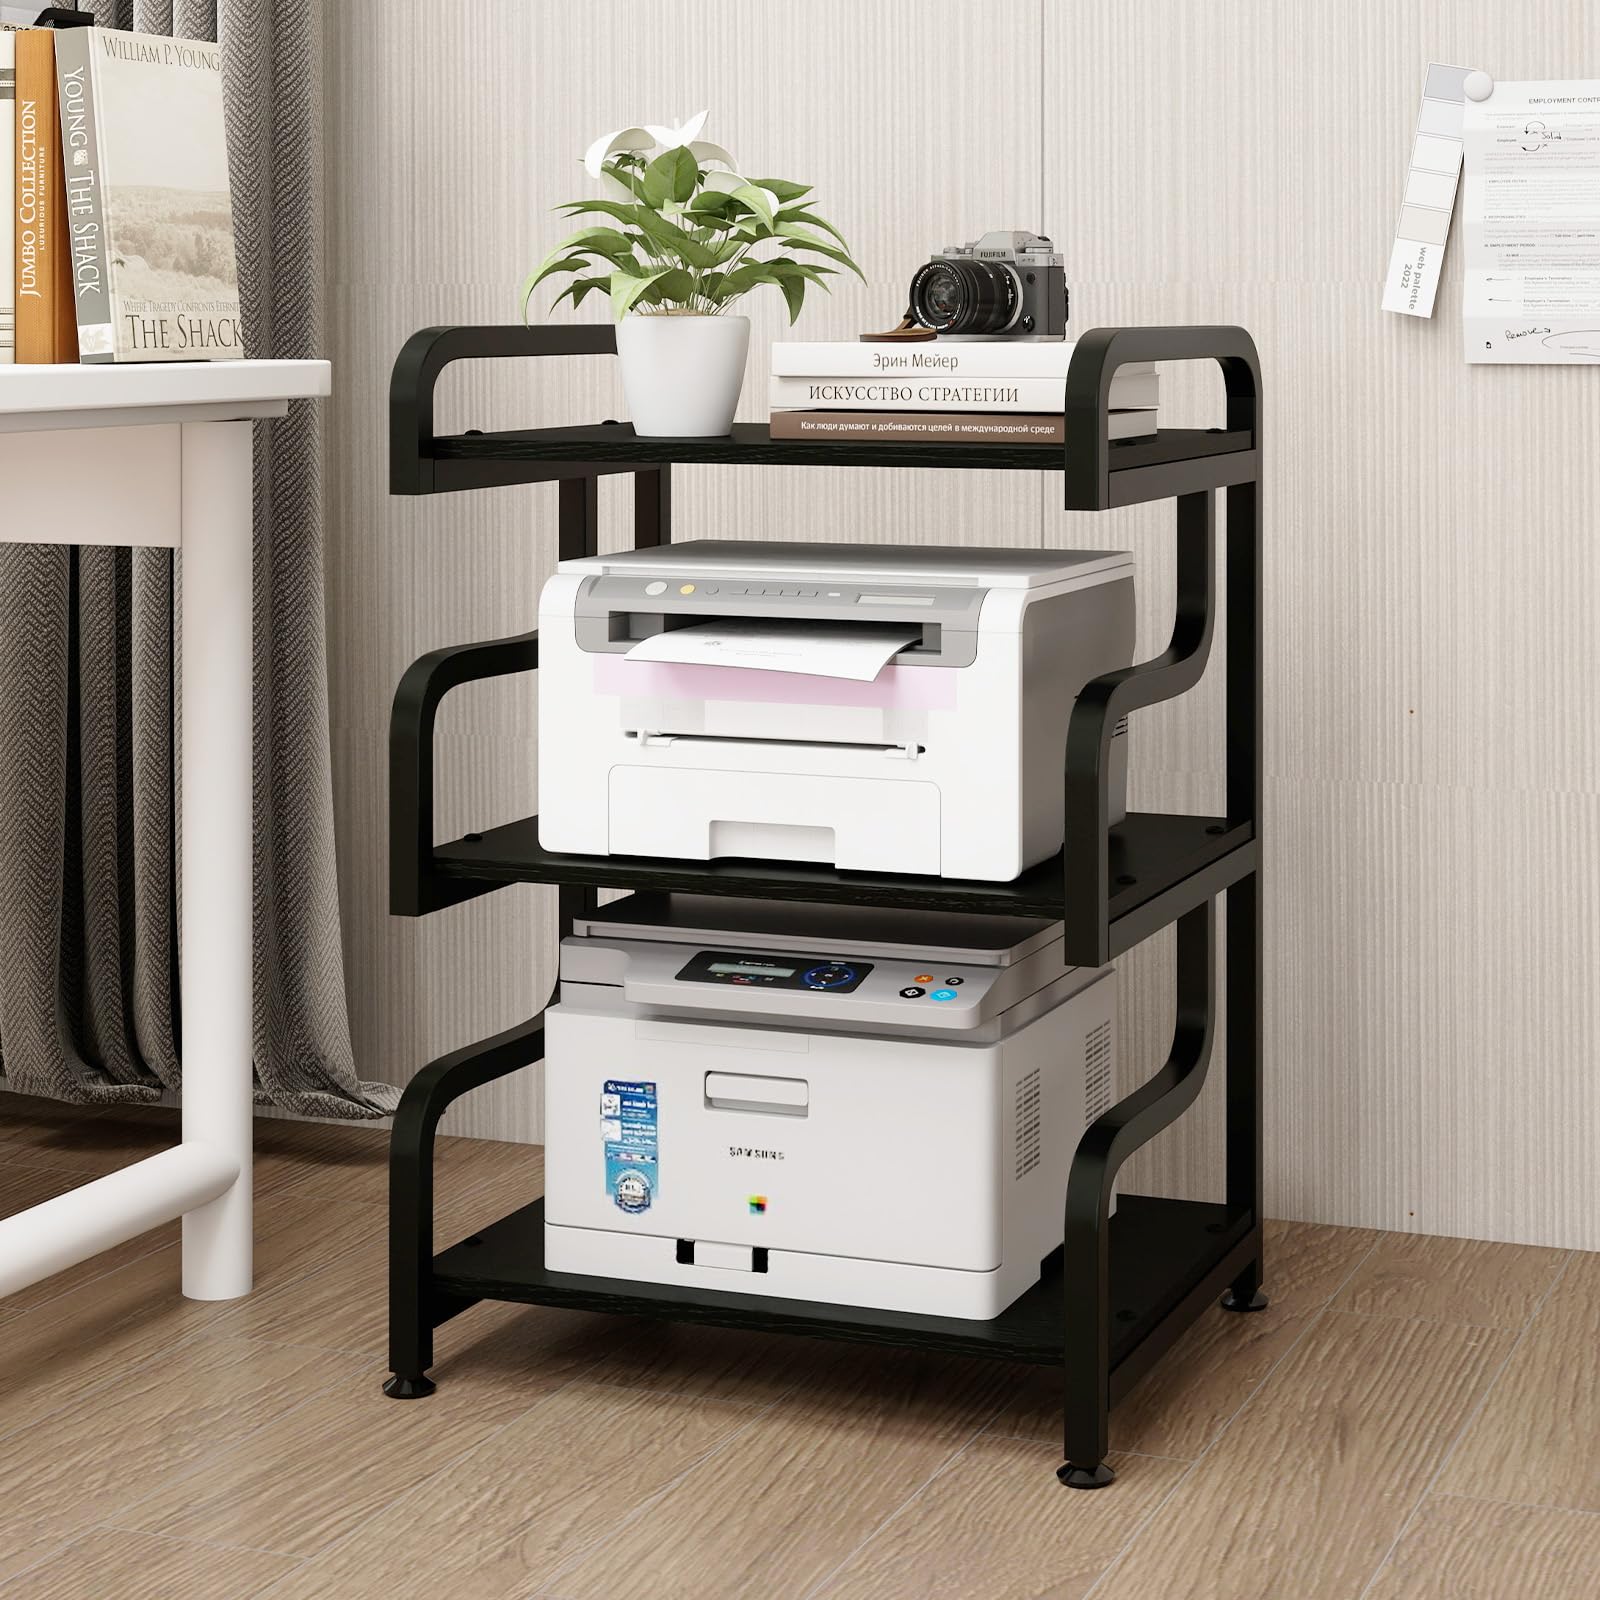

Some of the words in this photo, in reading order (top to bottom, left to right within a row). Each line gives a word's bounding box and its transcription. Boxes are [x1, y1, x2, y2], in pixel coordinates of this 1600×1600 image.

[103, 36, 161, 64] WILLIAM
[164, 43, 173, 65] P.
[174, 45, 220, 71] YOUNG
[64, 65, 88, 147] YOUNG
[20, 100, 36, 223] COLLECTION
[70, 170, 95, 216] THE
[20, 230, 41, 297] JUMBO
[73, 222, 101, 297] SHACK
[1400, 263, 1413, 289] 2022
[1417, 247, 1427, 270] web
[123, 301, 146, 312] WHERE
[147, 301, 177, 312] TRAGEDY
[177, 301, 214, 312] CONFRONTS
[1408, 272, 1421, 310] palette
[125, 314, 170, 349] THE
[177, 313, 243, 349] SHACK
[873, 353, 907, 371] Эрин
[912, 353, 959, 371] Мейер
[809, 385, 913, 401] ИСКУССТВО
[918, 387, 1018, 402] СТРАТЕГИИ
[801, 421, 815, 430] Как
[816, 422, 838, 431] люди
[838, 423, 869, 432] думают
[878, 422, 927, 432] добиваются
[928, 424, 953, 432] целей
[961, 425, 1029, 434] международной
[1030, 426, 1055, 434] среде
